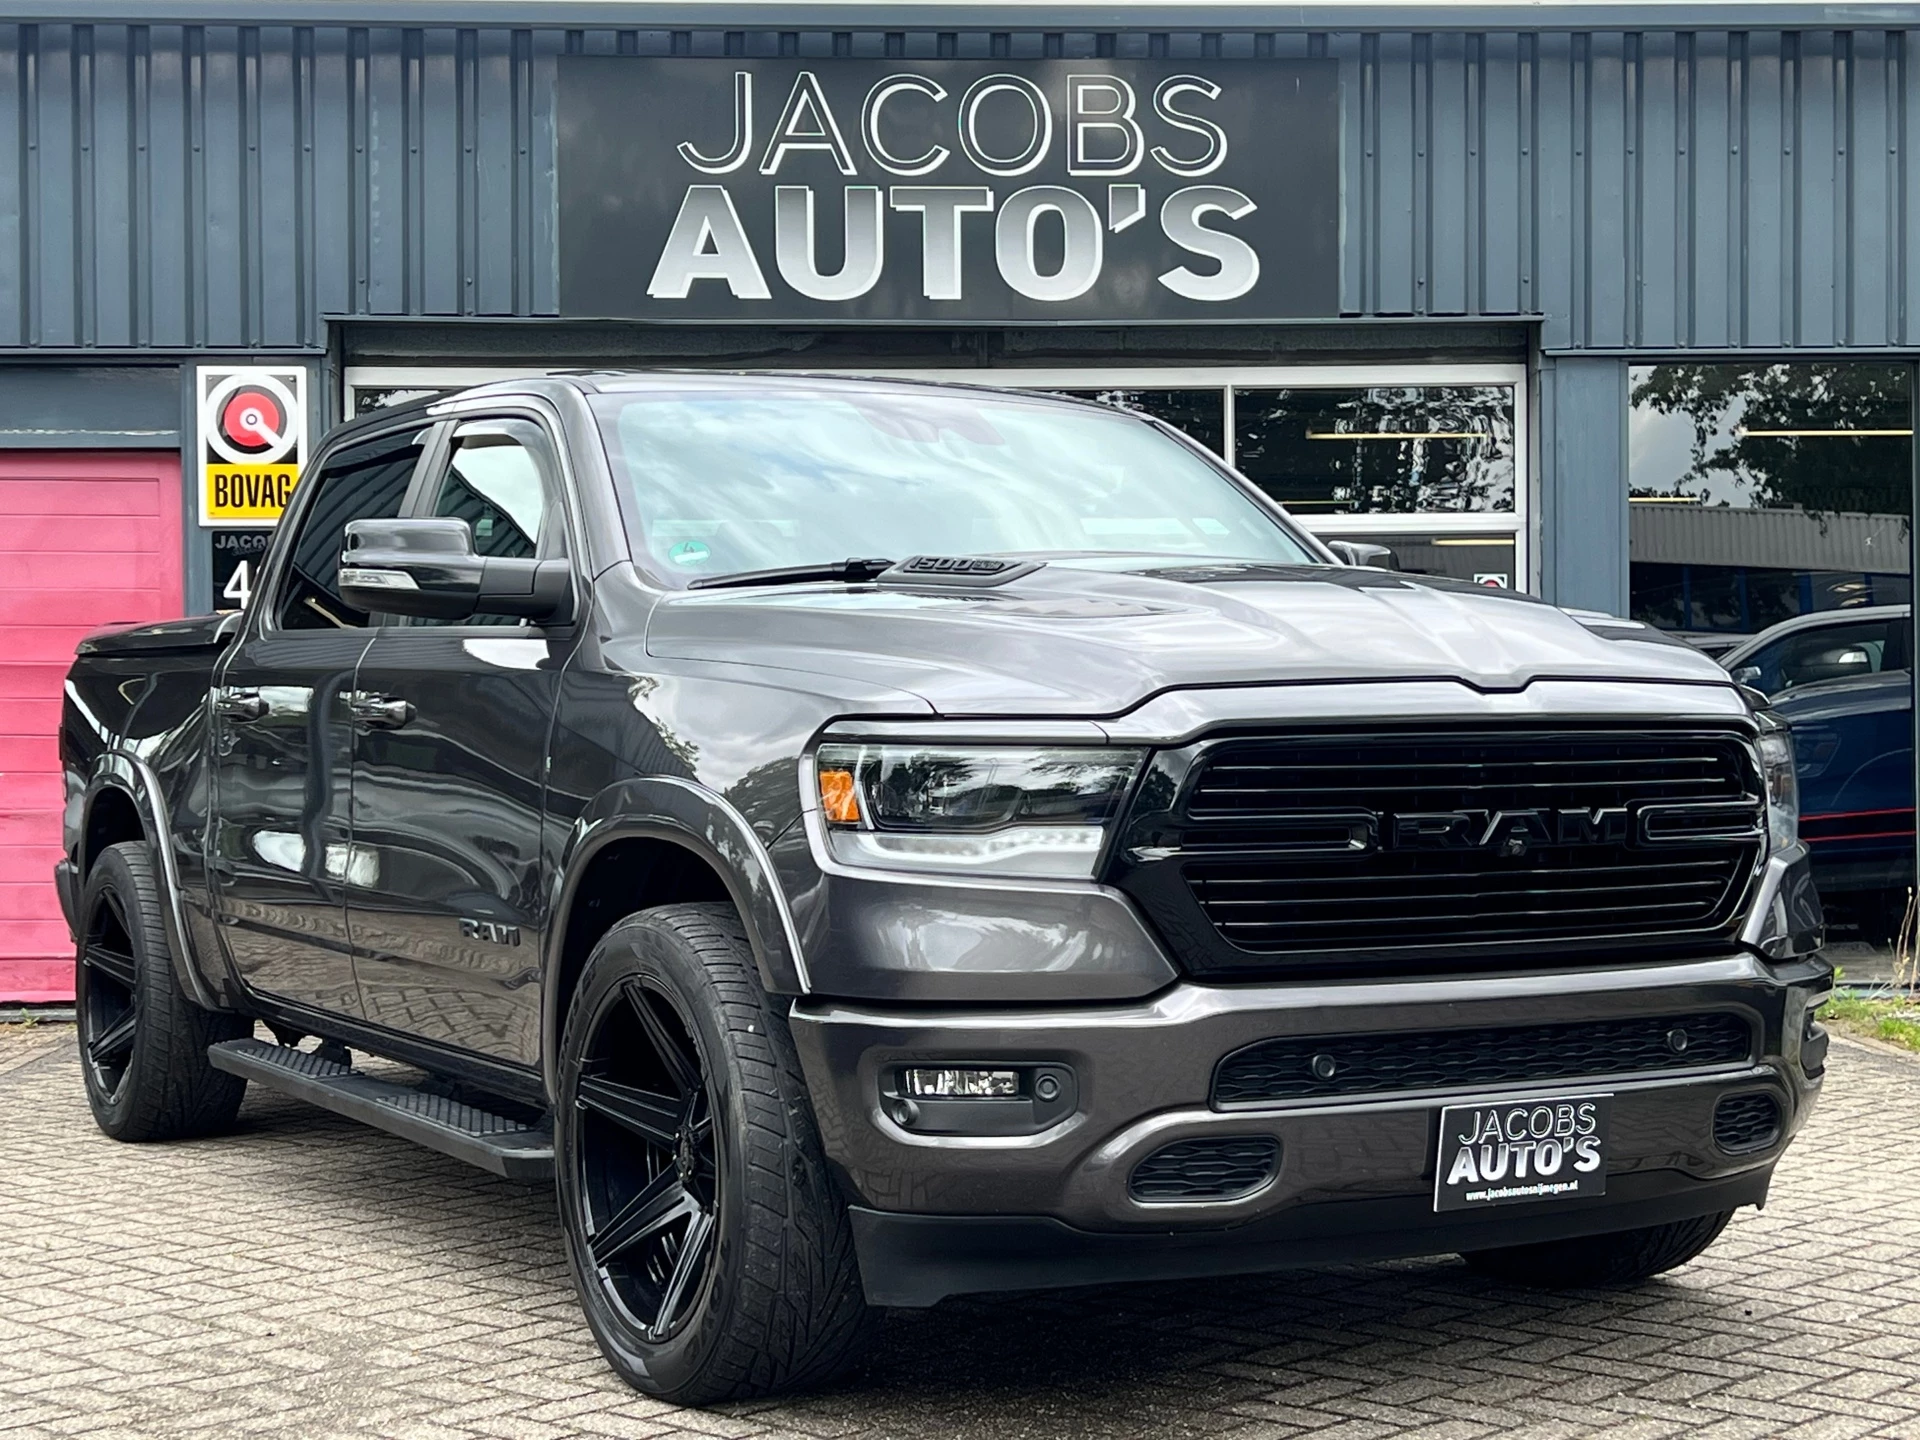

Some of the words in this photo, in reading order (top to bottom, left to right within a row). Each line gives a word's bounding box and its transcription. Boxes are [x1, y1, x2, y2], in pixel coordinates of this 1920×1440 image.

[676, 71, 1229, 177] JACOBS
[645, 184, 1261, 302] AUTO'S
[214, 474, 291, 508] BOVAG
[214, 535, 272, 549] JACO
[909, 557, 974, 571] 1500
[1393, 807, 1628, 848] RAM
[459, 918, 521, 947] RAM
[1458, 1102, 1597, 1145] JACOBS
[1446, 1135, 1602, 1185] AUTO'S
[1465, 1179, 1579, 1201] www.jacobsautosnijmegen.nl
